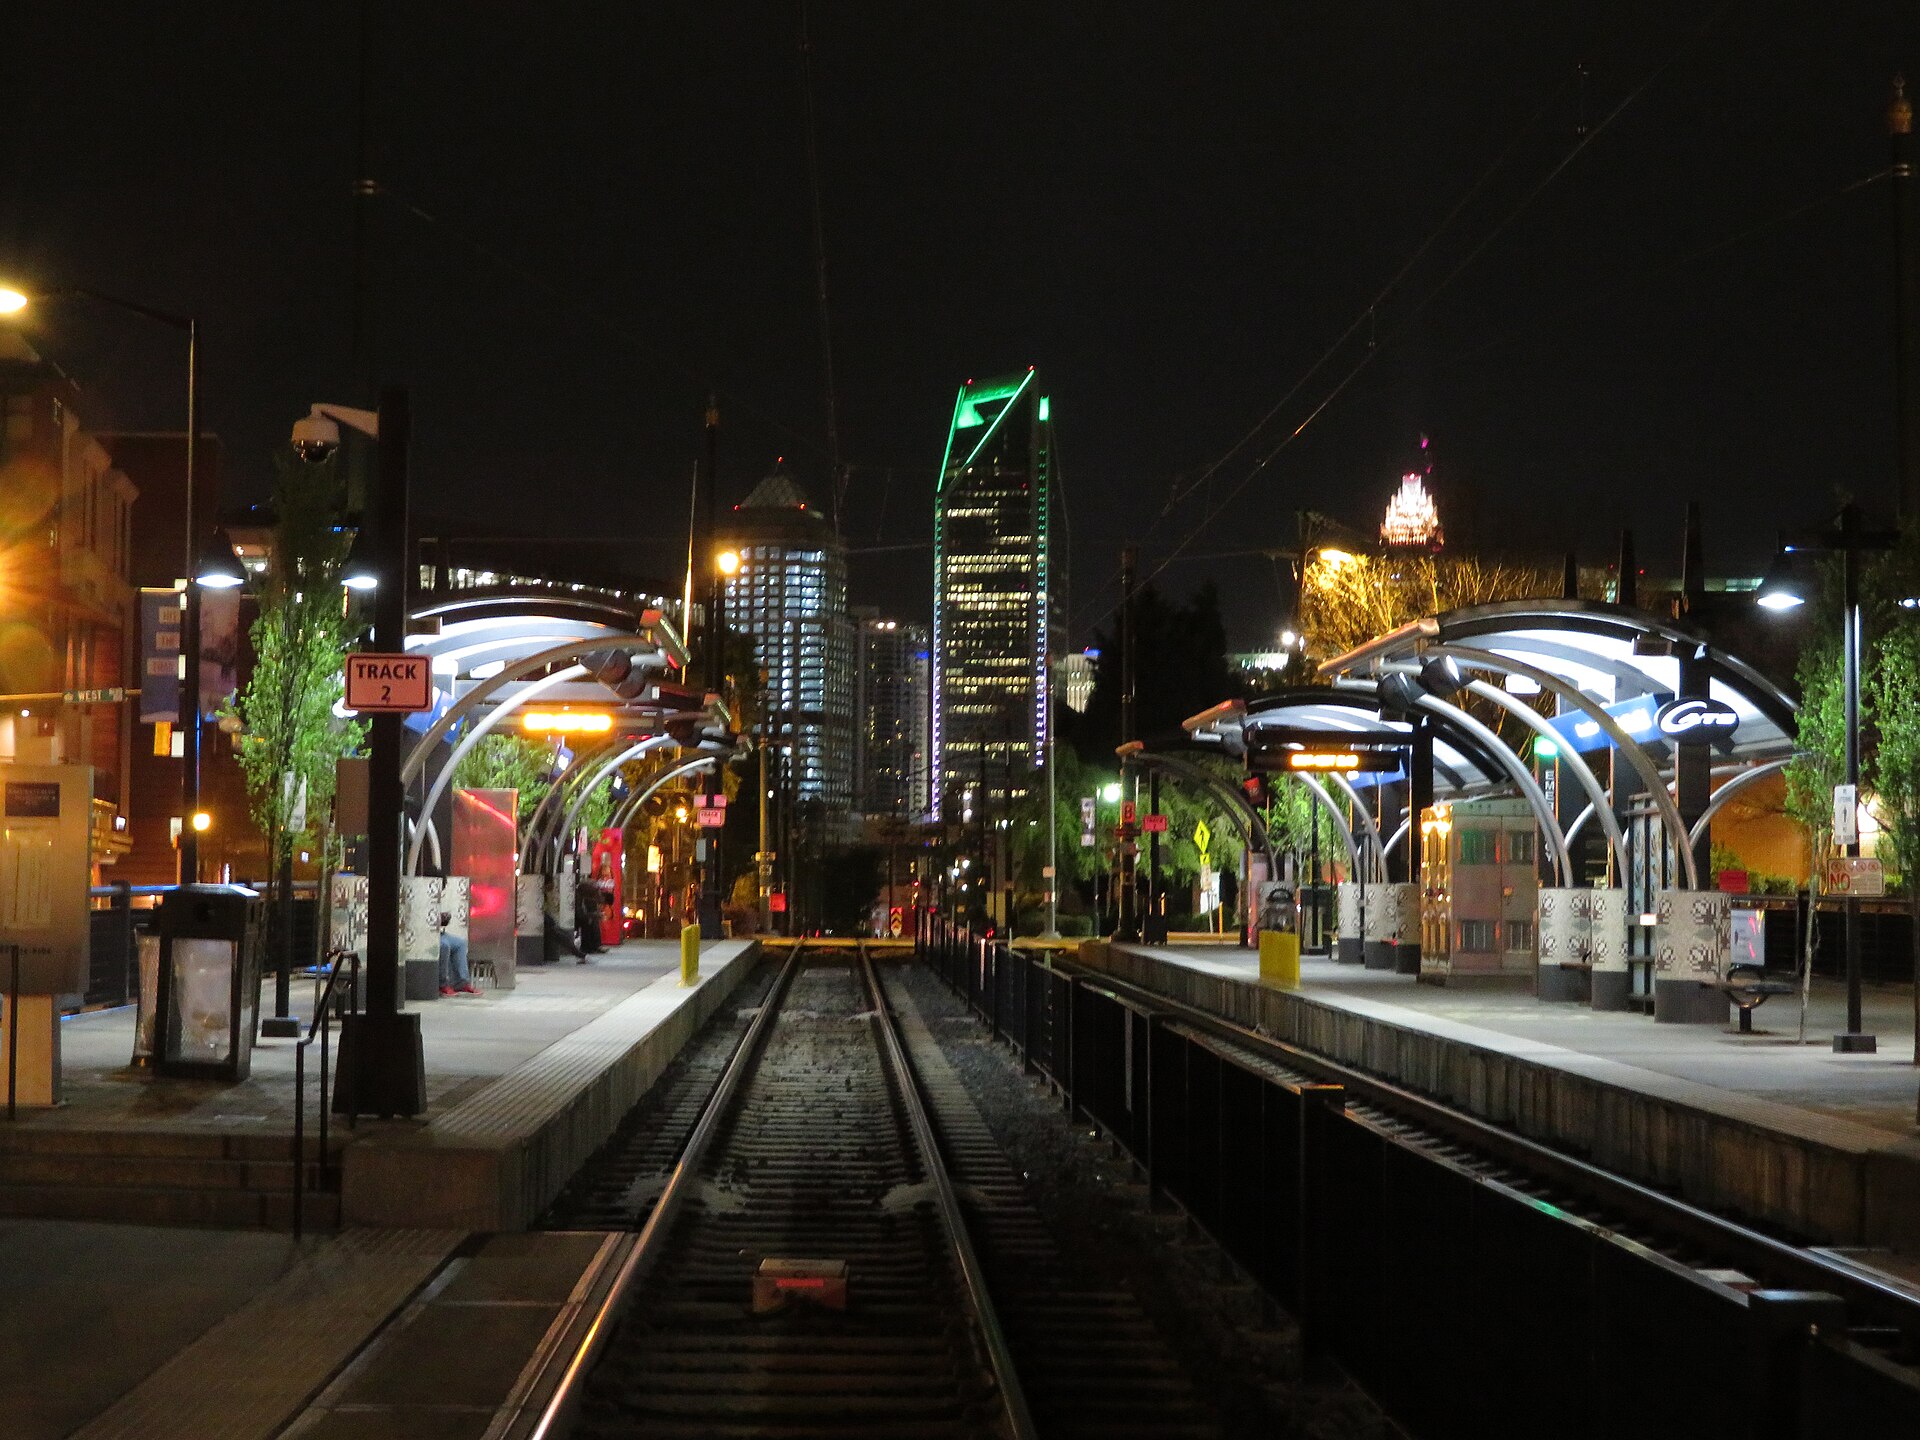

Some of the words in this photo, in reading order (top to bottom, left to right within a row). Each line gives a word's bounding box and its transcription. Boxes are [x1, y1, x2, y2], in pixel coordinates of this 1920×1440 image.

[356, 663, 418, 679] TRACK
[381, 685, 391, 701] 2
[1829, 872, 1852, 892] NO
